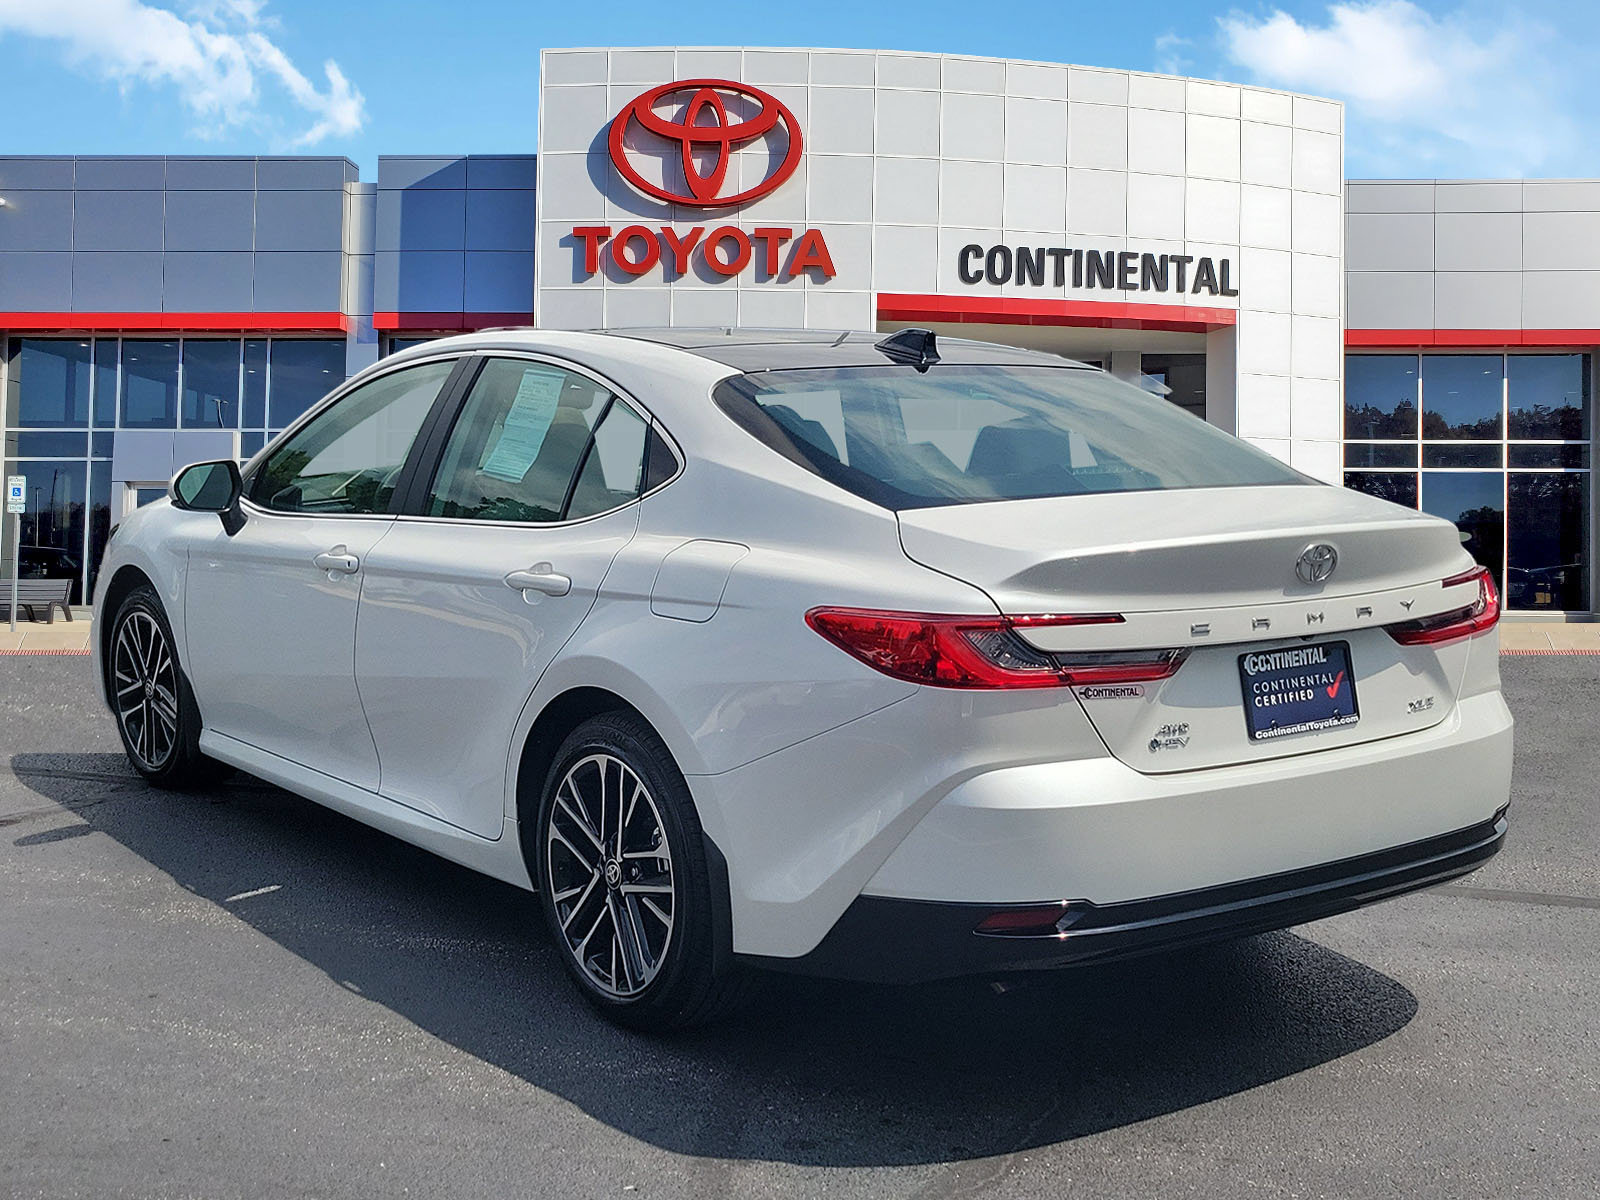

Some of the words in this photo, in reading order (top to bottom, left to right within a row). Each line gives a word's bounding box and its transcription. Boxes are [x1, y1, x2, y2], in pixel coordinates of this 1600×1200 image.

[573, 226, 836, 277] TOYOTA
[959, 244, 1239, 297] CONTINENTAL
[1191, 600, 1415, 638] CAMRY
[1248, 647, 1327, 672] CONTINENTAL
[1086, 687, 1139, 698] CONTINENTAL
[1253, 672, 1334, 694] CONTINENTAL
[1255, 689, 1314, 708] CERTIFIED
[1255, 715, 1359, 739] ContinentalToyota.com
